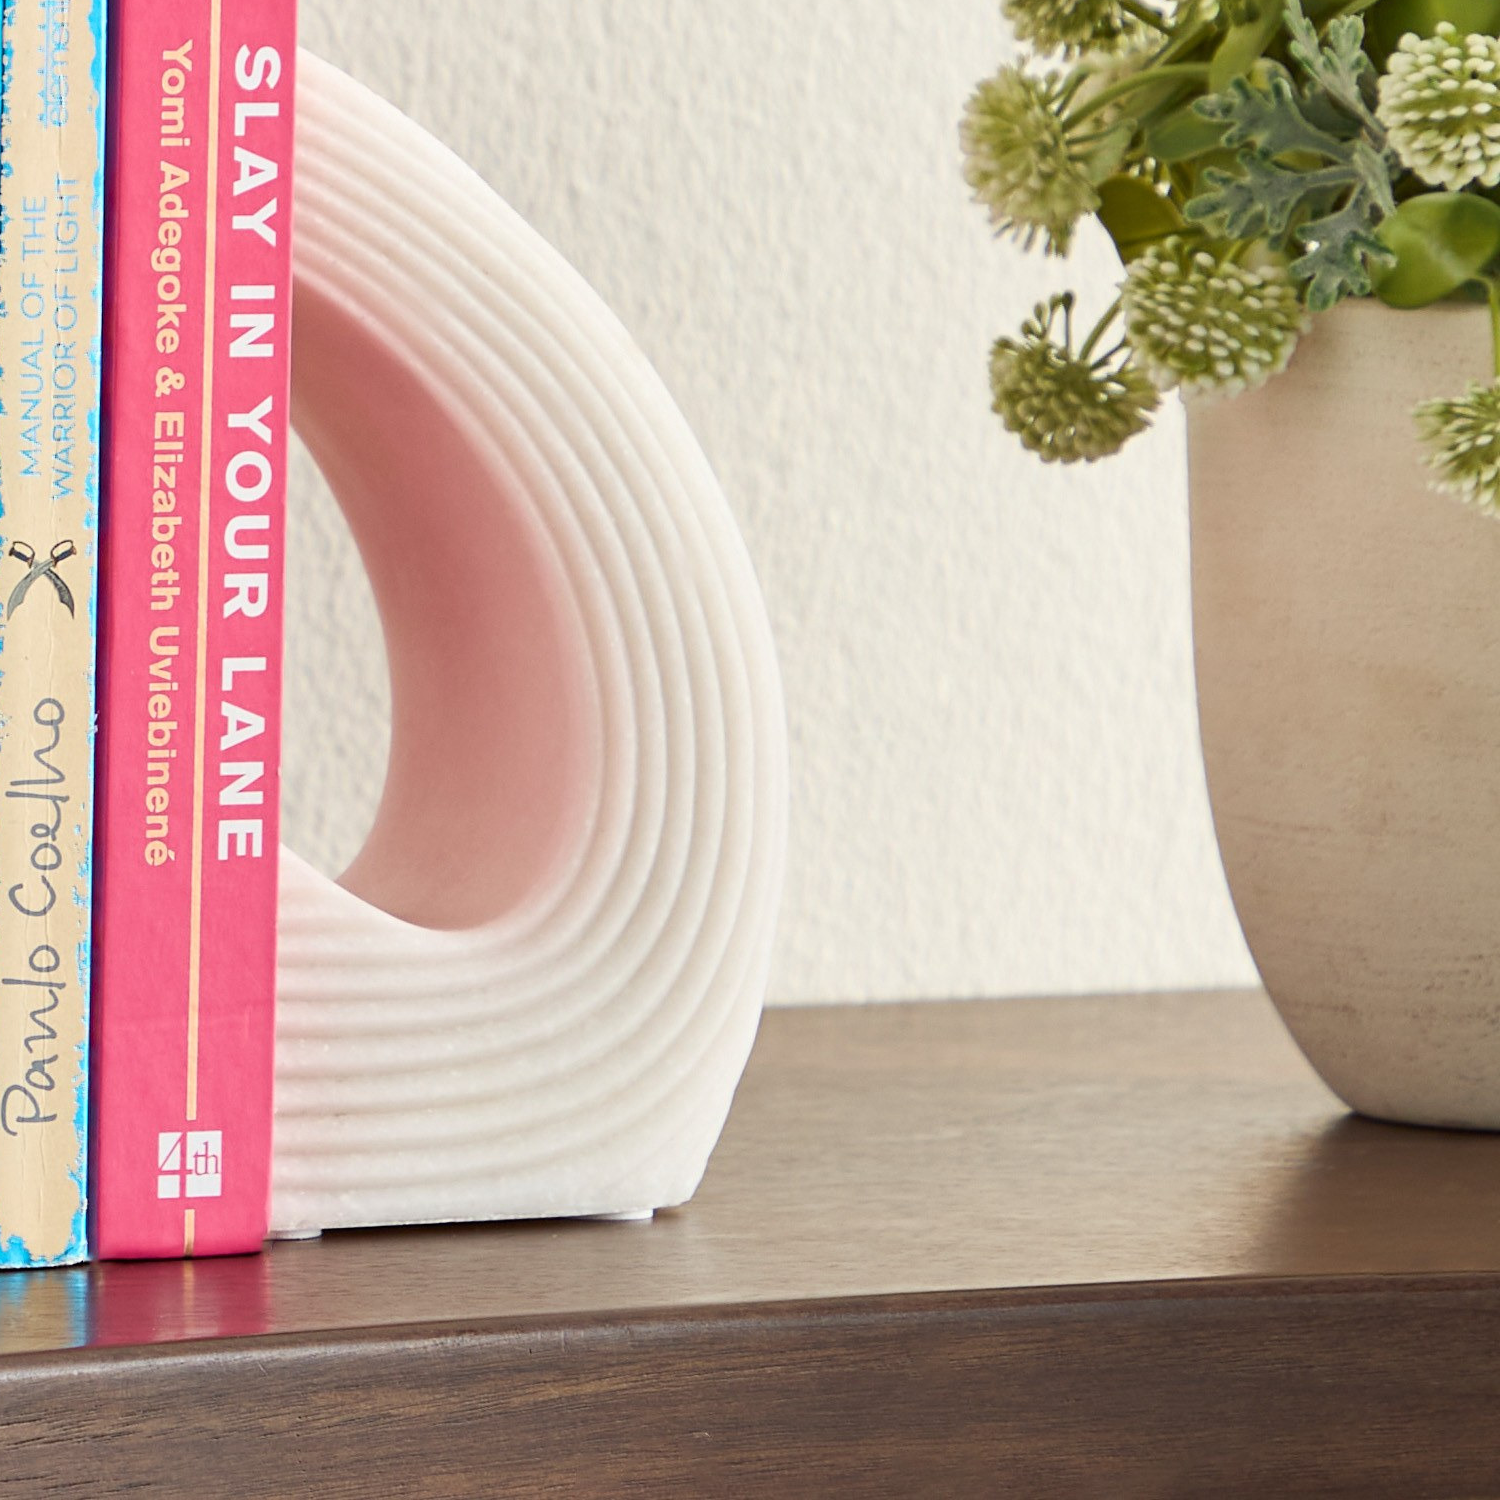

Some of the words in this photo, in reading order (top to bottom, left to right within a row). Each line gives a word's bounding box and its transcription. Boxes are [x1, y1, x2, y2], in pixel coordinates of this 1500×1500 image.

[160, 39, 193, 148] Yomi
[231, 44, 282, 247] SLAY
[20, 272, 46, 320] OF
[22, 196, 47, 261] THE
[54, 171, 80, 274] LIGHT
[151, 160, 191, 355] Adegoke
[53, 284, 79, 331] OF
[154, 366, 186, 398] &
[228, 284, 276, 358] IN
[19, 328, 46, 478] MANUAL
[51, 340, 78, 501] WARRIOR
[149, 411, 186, 611] Elizabeth
[223, 395, 273, 619] YOUR
[5, 697, 71, 918] Coelho
[144, 626, 180, 867] Uviebinené
[217, 656, 267, 861] LANE
